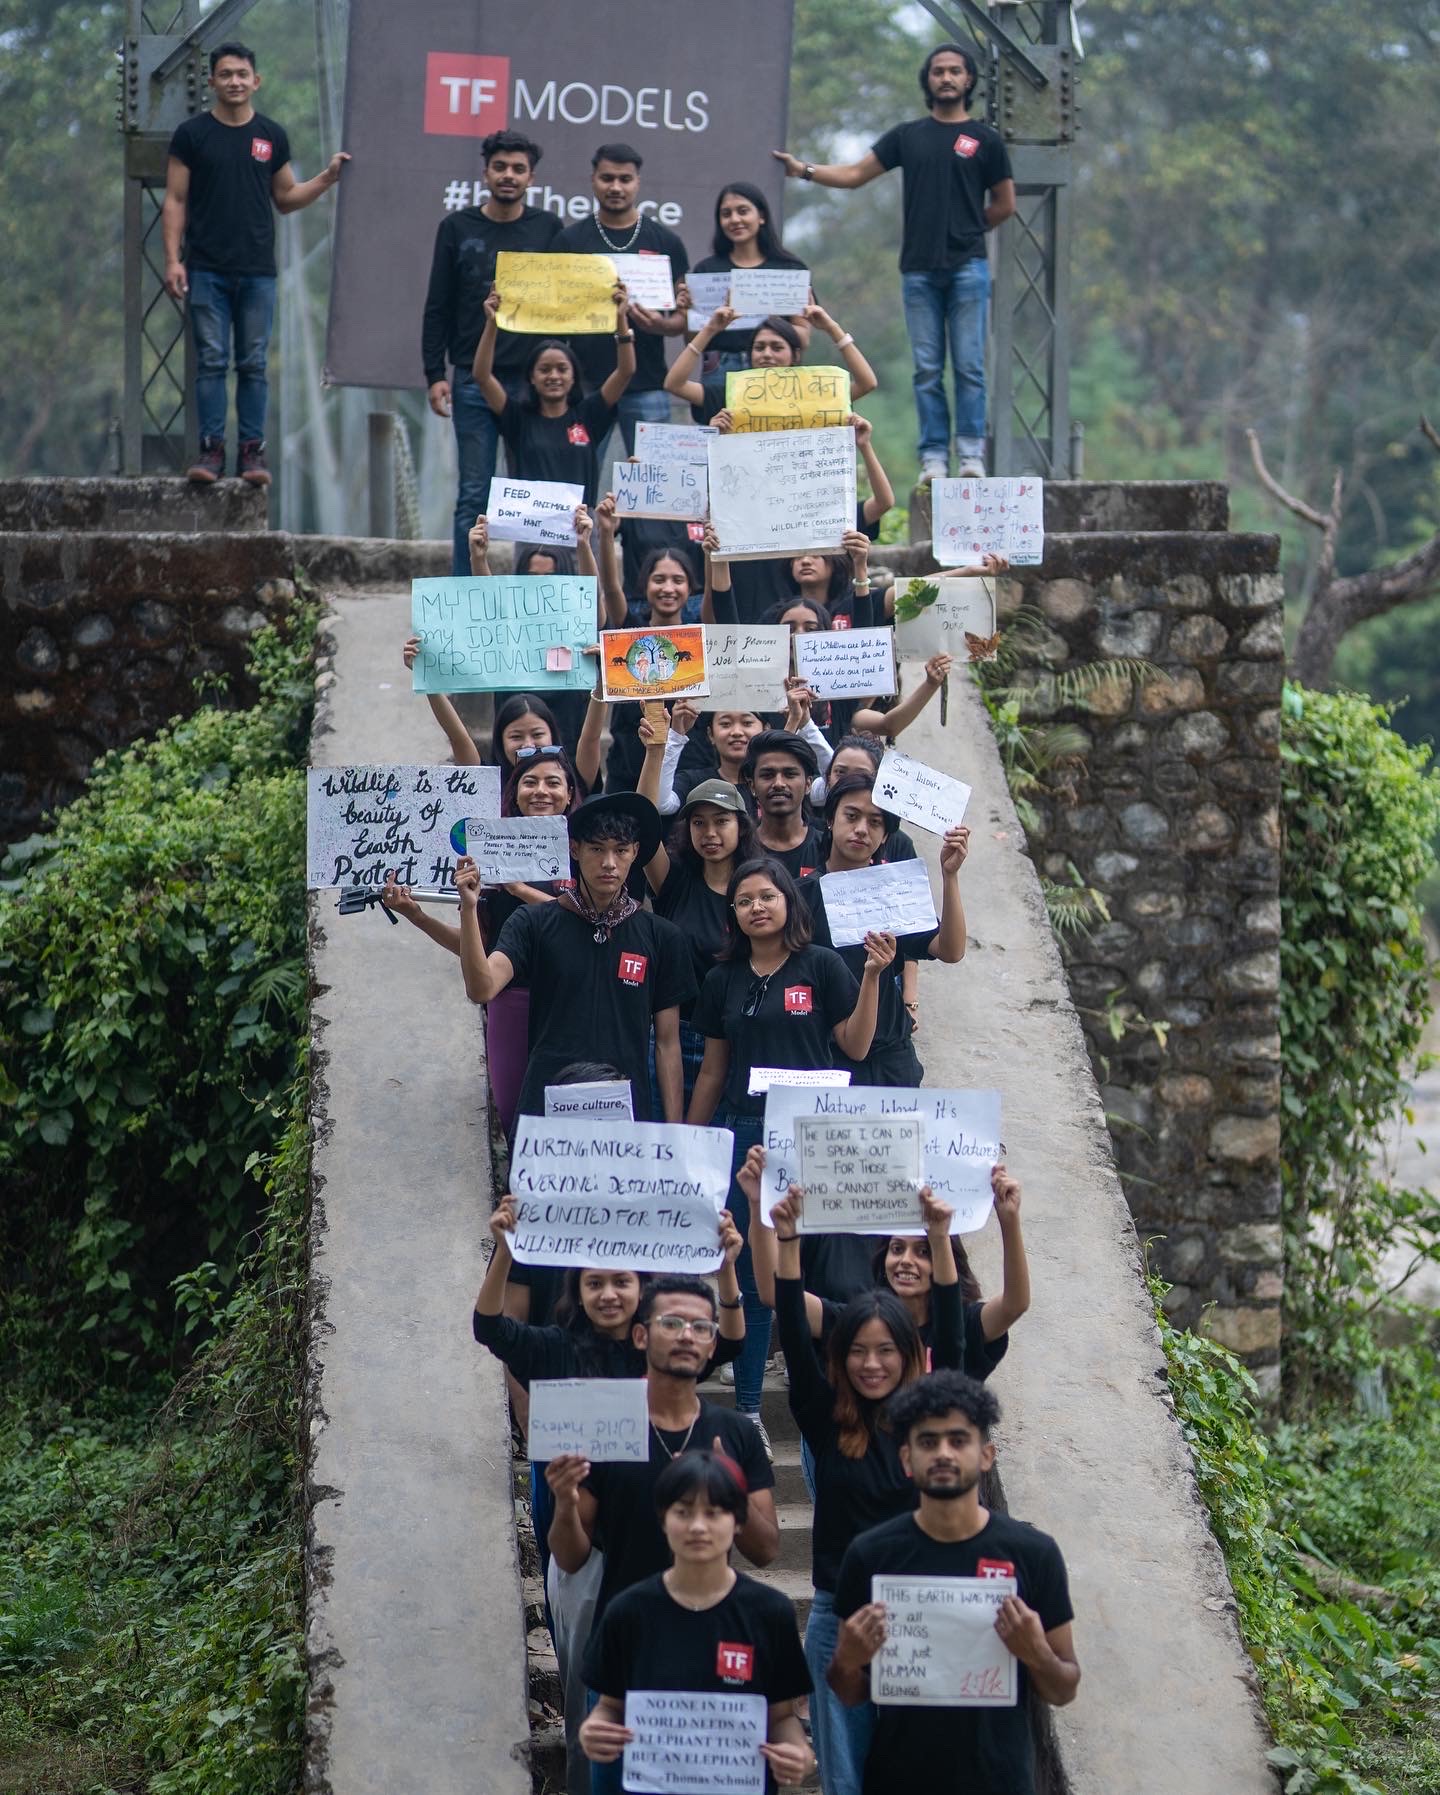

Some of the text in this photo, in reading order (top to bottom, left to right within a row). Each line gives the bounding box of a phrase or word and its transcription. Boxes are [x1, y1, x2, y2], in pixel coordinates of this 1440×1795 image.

[440, 76, 710, 132] TF MODELS
[619, 463, 697, 487] Wildlife is
[503, 487, 531, 499] FEED
[645, 484, 666, 504] life
[771, 521, 808, 532] WILDLIFE
[421, 590, 460, 623] MY
[468, 583, 572, 621] CULTURE
[322, 769, 401, 805] Wildlife
[444, 770, 478, 796] the
[341, 799, 444, 839] beauty of
[352, 829, 422, 859] Earth
[332, 856, 419, 886] Protect
[624, 959, 642, 975] TF
[622, 978, 639, 988] Model
[789, 992, 807, 1004] TF
[790, 1009, 808, 1017] Model
[553, 1099, 625, 1113] Save culture,
[825, 1129, 851, 1141] LEAST
[872, 1129, 892, 1140] CAN
[901, 1129, 912, 1140] DO
[591, 1140, 646, 1158] NATURE
[652, 1144, 673, 1160] IS
[804, 1145, 891, 1157] IS SPEAK OUT
[834, 1162, 854, 1174] FOR
[804, 1183, 828, 1194] WHO
[836, 1182, 880, 1194] CANNOT
[822, 1200, 844, 1211] FOR
[517, 1202, 692, 1227] BE UNITED FOR THE
[514, 1232, 583, 1254] WILDLIFE
[917, 1590, 954, 1604] EARTH
[723, 1651, 748, 1670] TF
[882, 1666, 926, 1679] HUMAN
[646, 1699, 749, 1713] NO ONE IN THE
[635, 1716, 757, 1730] WORLD NEEDS AN
[639, 1733, 751, 1748] ELEPHANT TUSK
[632, 1752, 757, 1767] BUT AN ELEPHANT
[664, 1772, 710, 1785] Thomas
[713, 1774, 760, 1787] Schmidt
